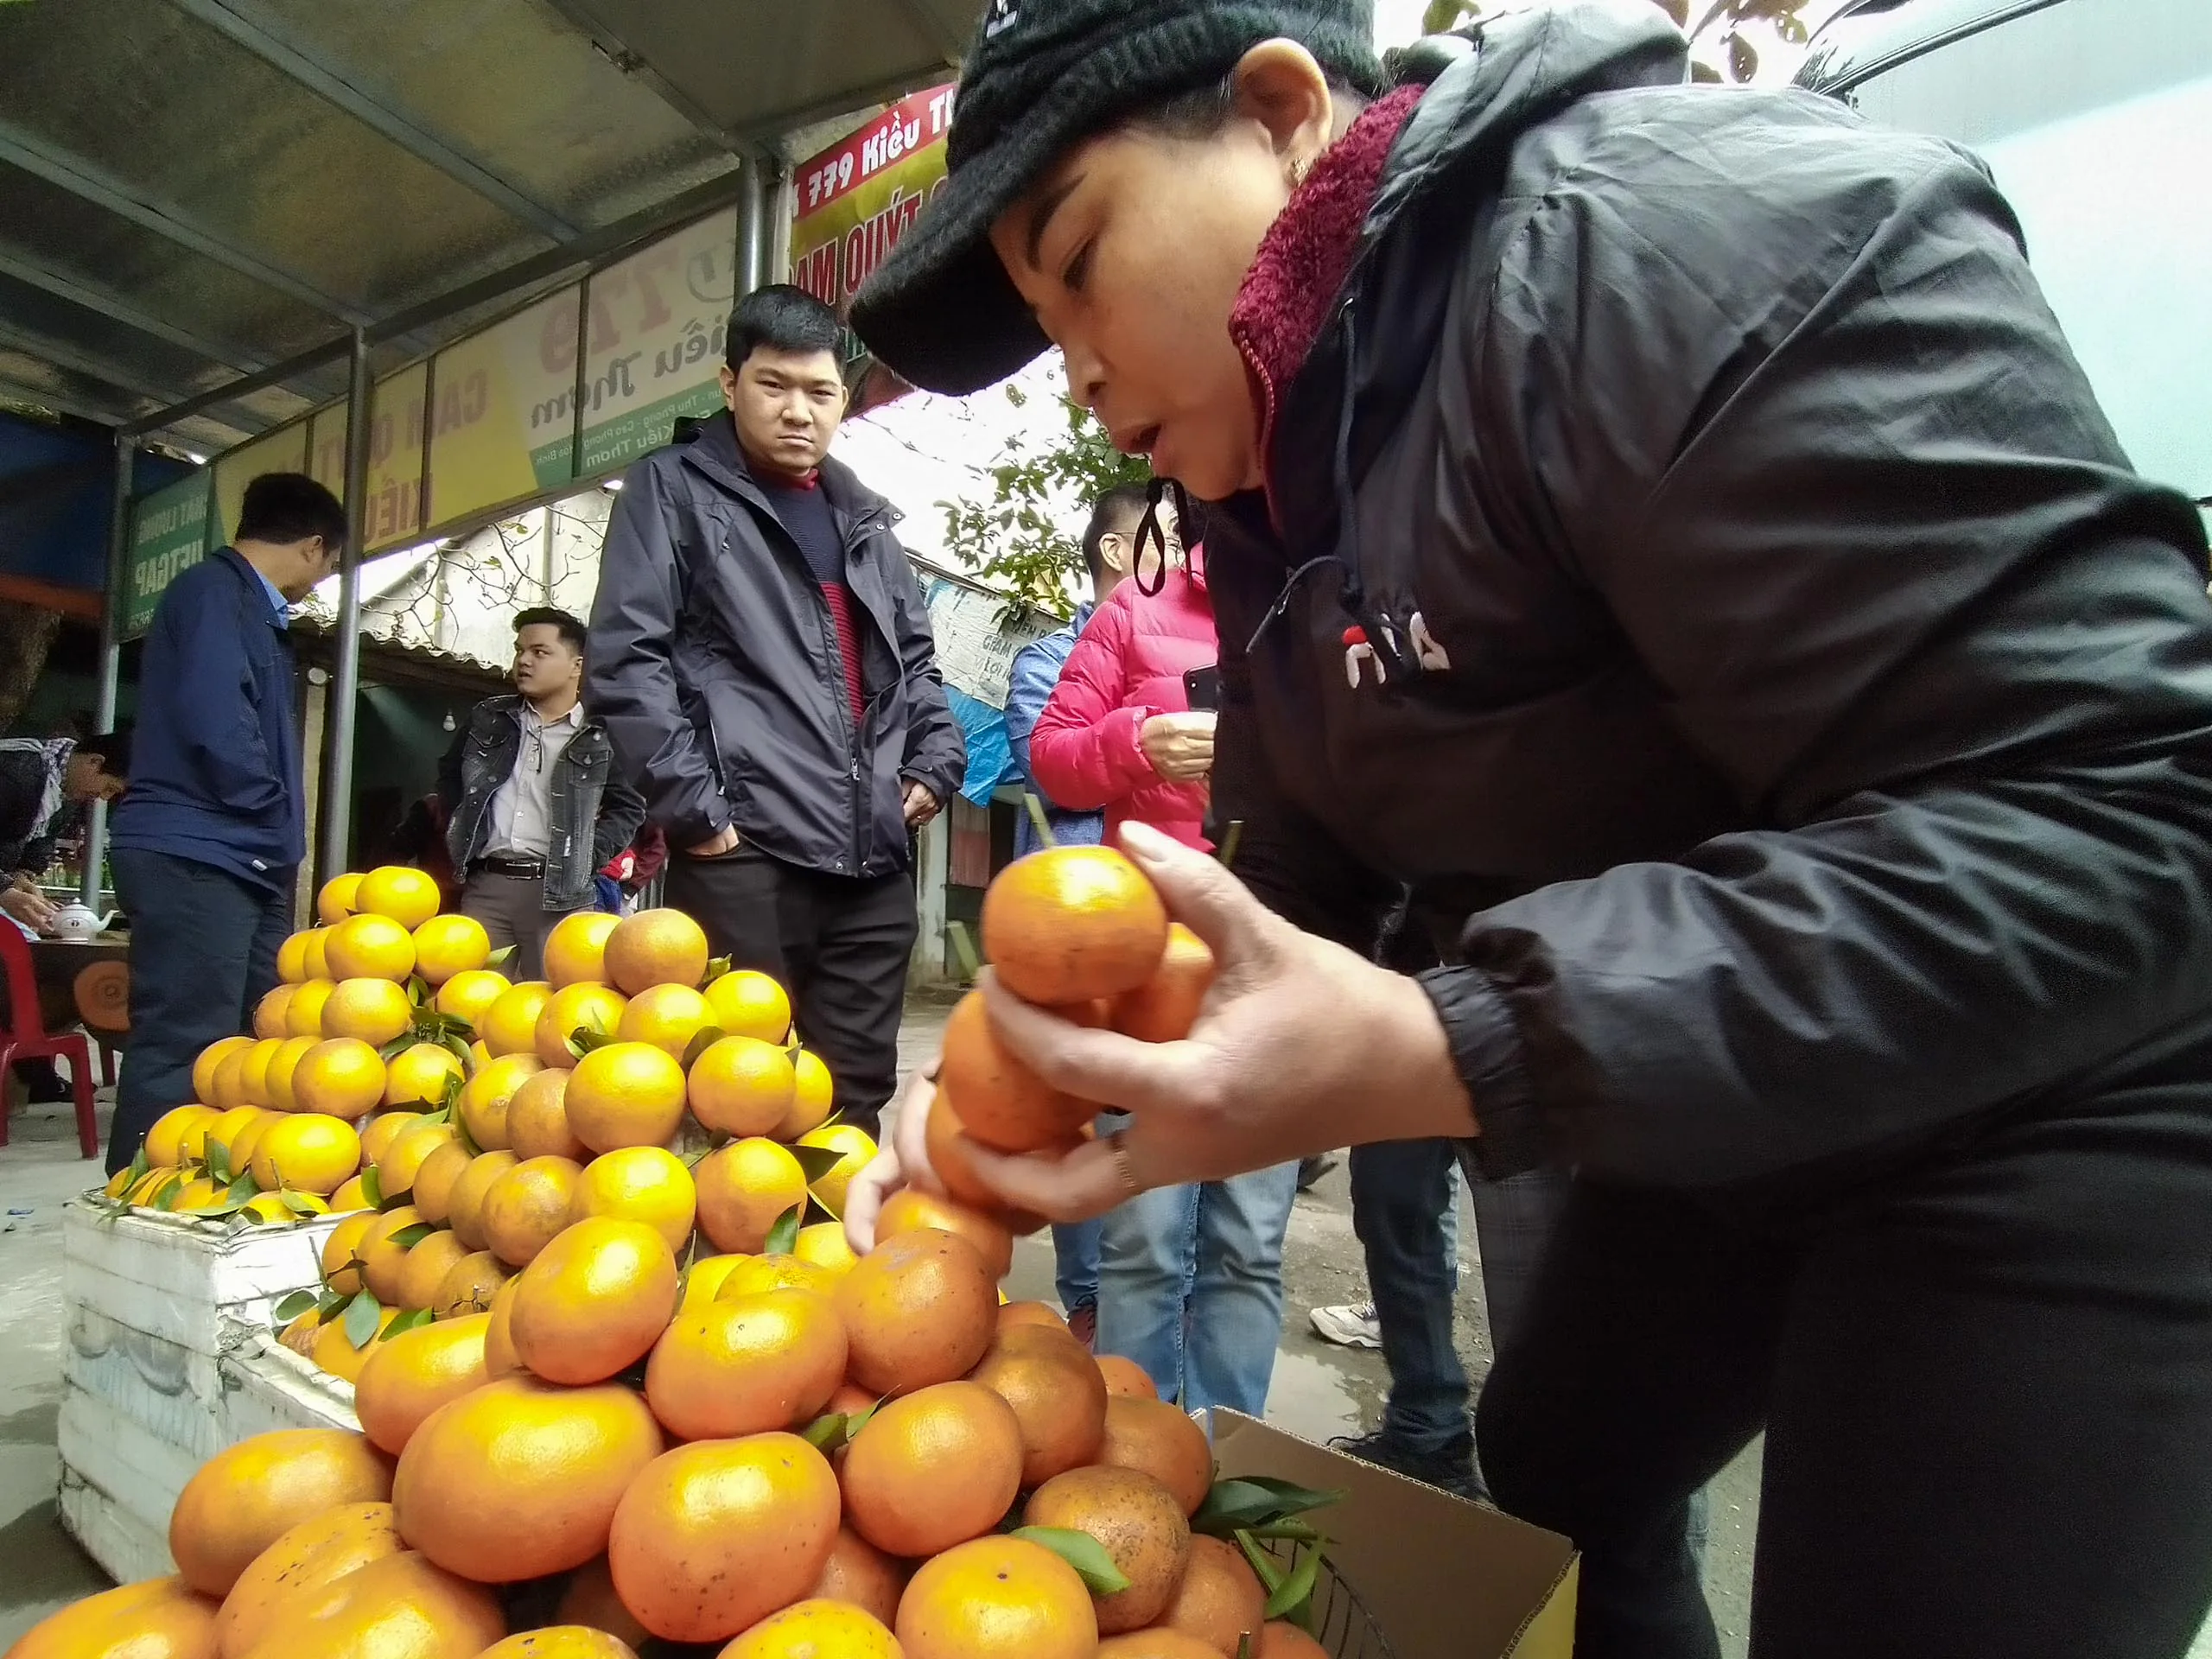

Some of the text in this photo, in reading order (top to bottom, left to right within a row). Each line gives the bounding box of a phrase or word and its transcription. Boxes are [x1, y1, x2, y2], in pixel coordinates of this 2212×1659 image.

[808, 151, 855, 208] 779
[861, 110, 921, 177] Kiều
[788, 238, 839, 306] AM
